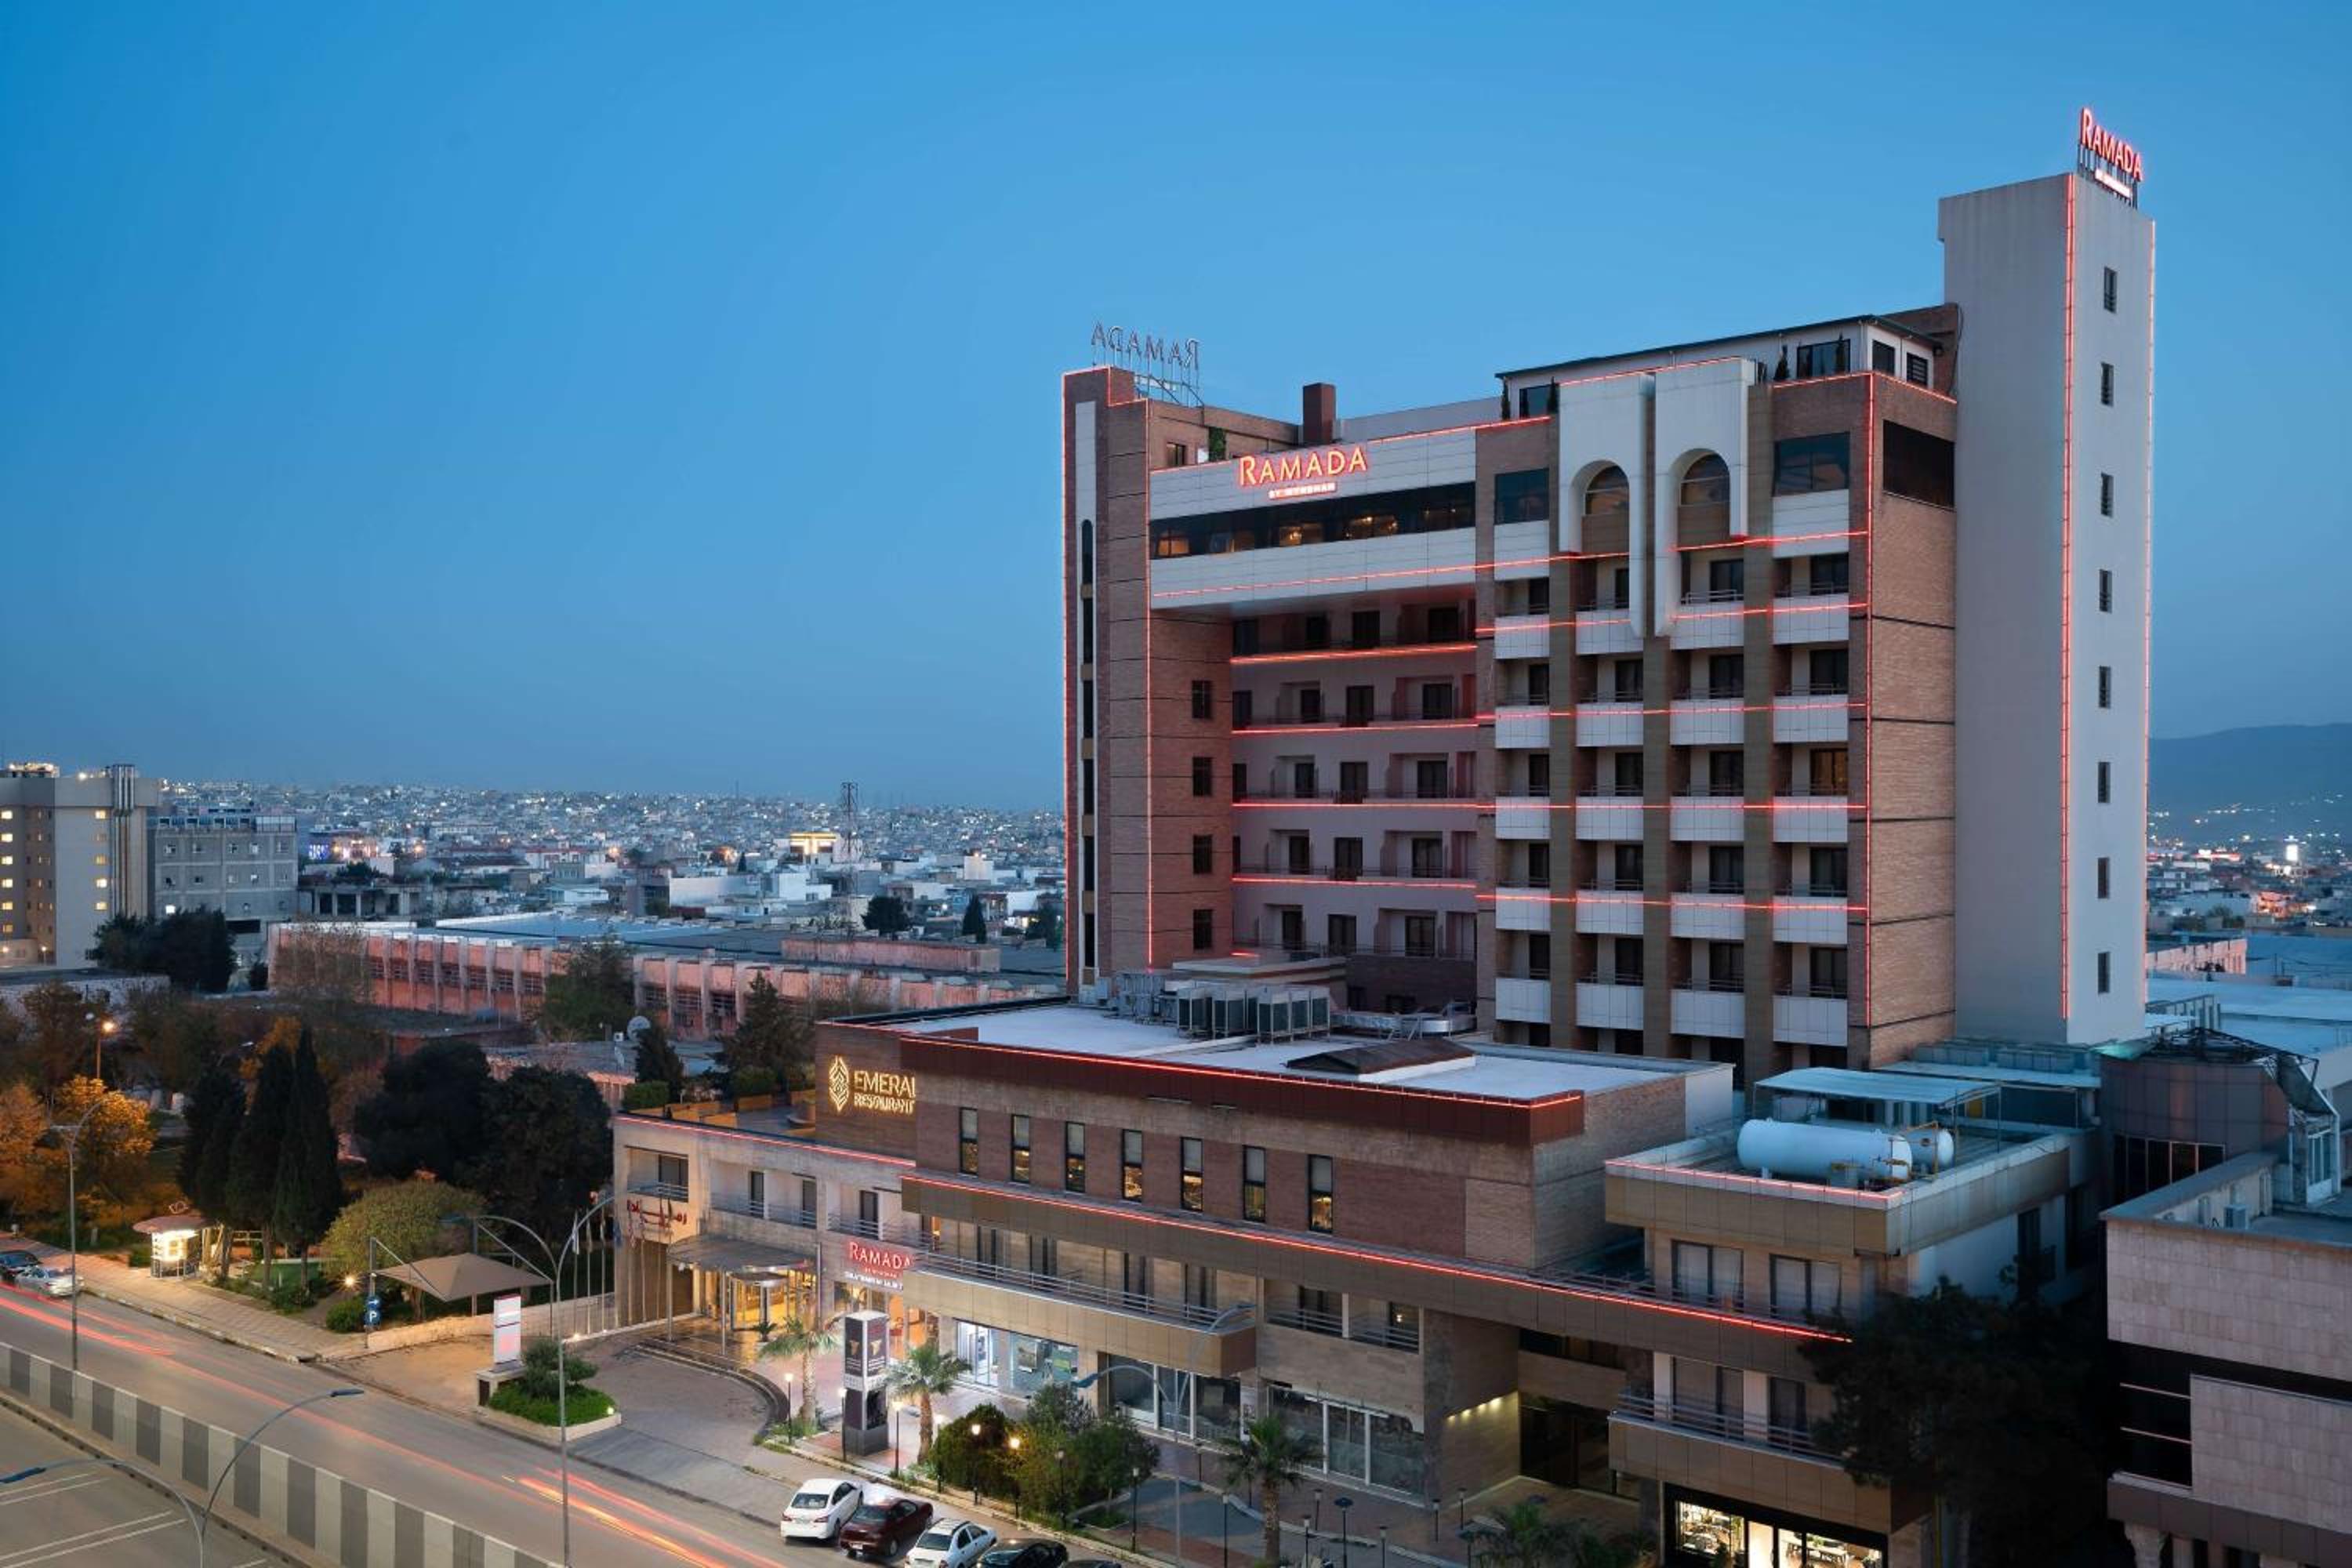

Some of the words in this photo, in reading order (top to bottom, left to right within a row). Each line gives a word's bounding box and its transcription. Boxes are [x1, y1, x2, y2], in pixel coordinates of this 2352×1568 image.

[2080, 107, 2143, 182] RAMADA
[1240, 446, 1367, 485] RAMADA
[849, 1241, 914, 1269] RAMADA
[369, 1310, 377, 1323] P
